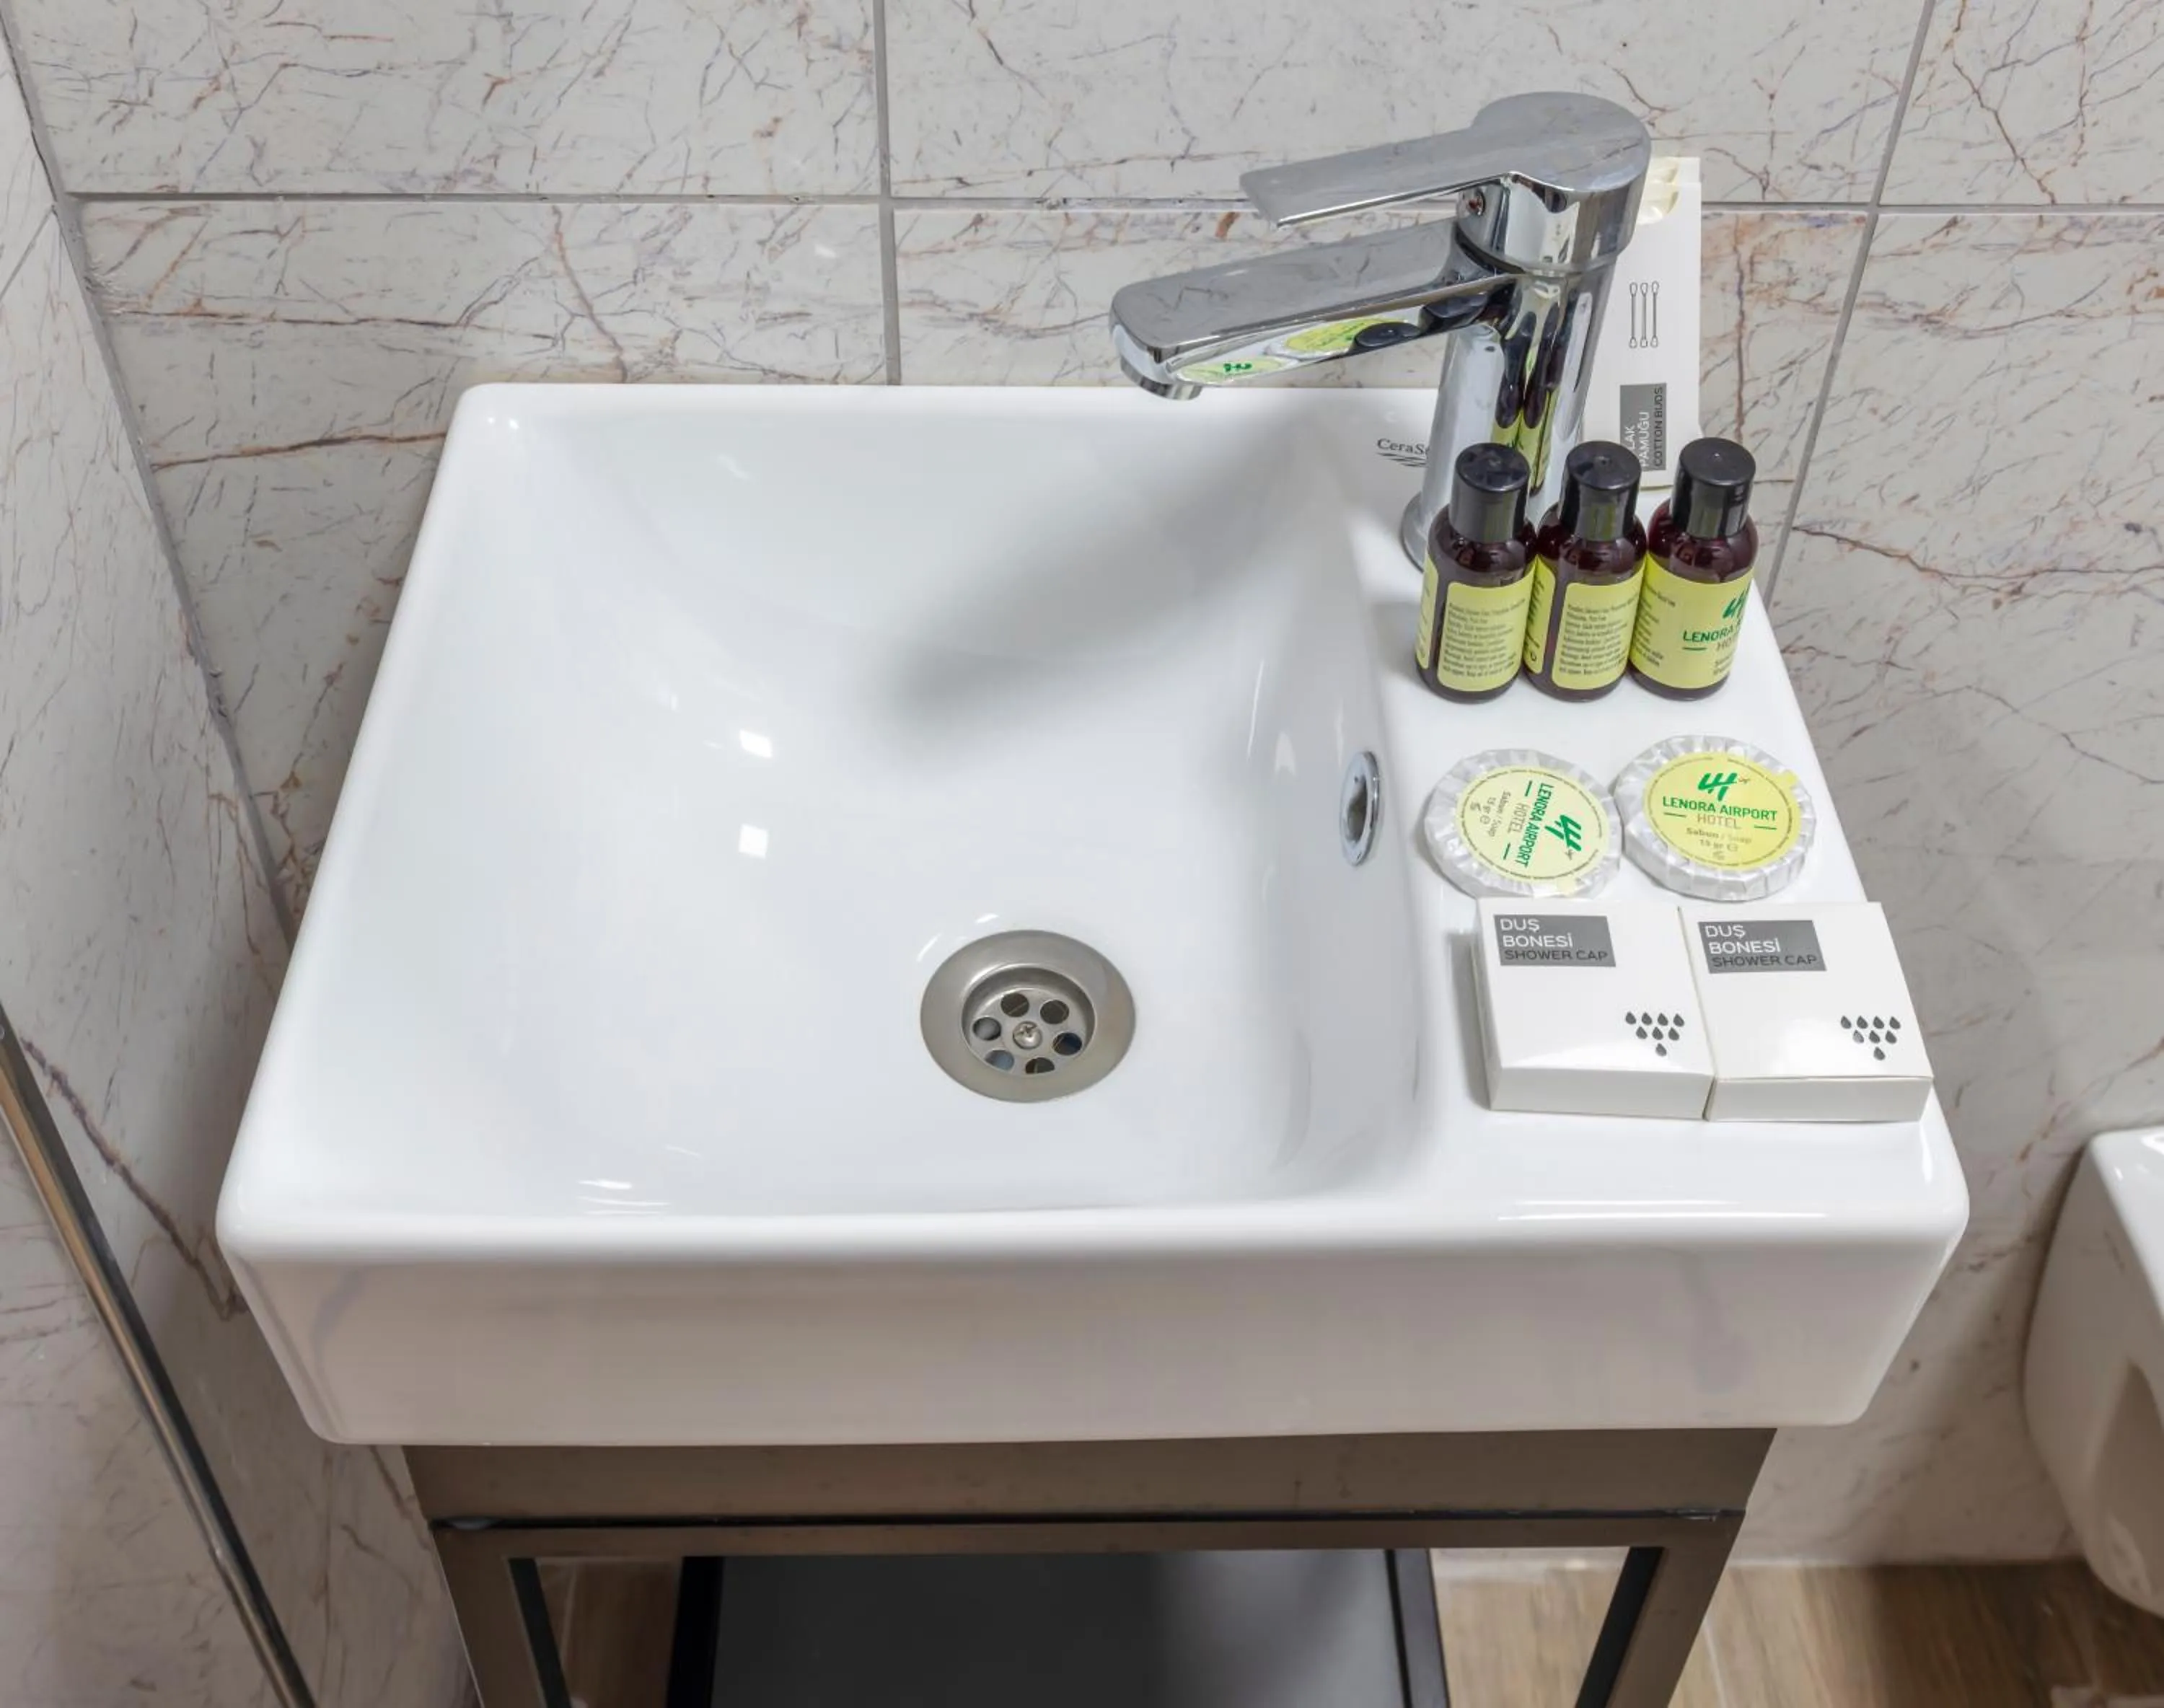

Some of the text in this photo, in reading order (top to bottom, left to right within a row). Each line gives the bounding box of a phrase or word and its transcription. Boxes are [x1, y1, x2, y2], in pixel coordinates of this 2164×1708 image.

[1654, 387, 1663, 467] COTTON BUDS
[1624, 425, 1636, 449] LAK
[1663, 796, 1777, 822] LENORA AIRPORT
[1508, 803, 1531, 833] HOTEL
[1515, 783, 1554, 868] LENORA AIRPORT
[1697, 813, 1741, 829] HOTEL
[1500, 918, 1540, 933] DUŞ
[1705, 925, 1746, 938] DUŞ
[1503, 932, 1573, 948] BONESİ
[1708, 938, 1781, 954] BONESİ
[1504, 949, 1609, 961] SHOWER CAP
[1712, 954, 1817, 967] SHOWER CAP
